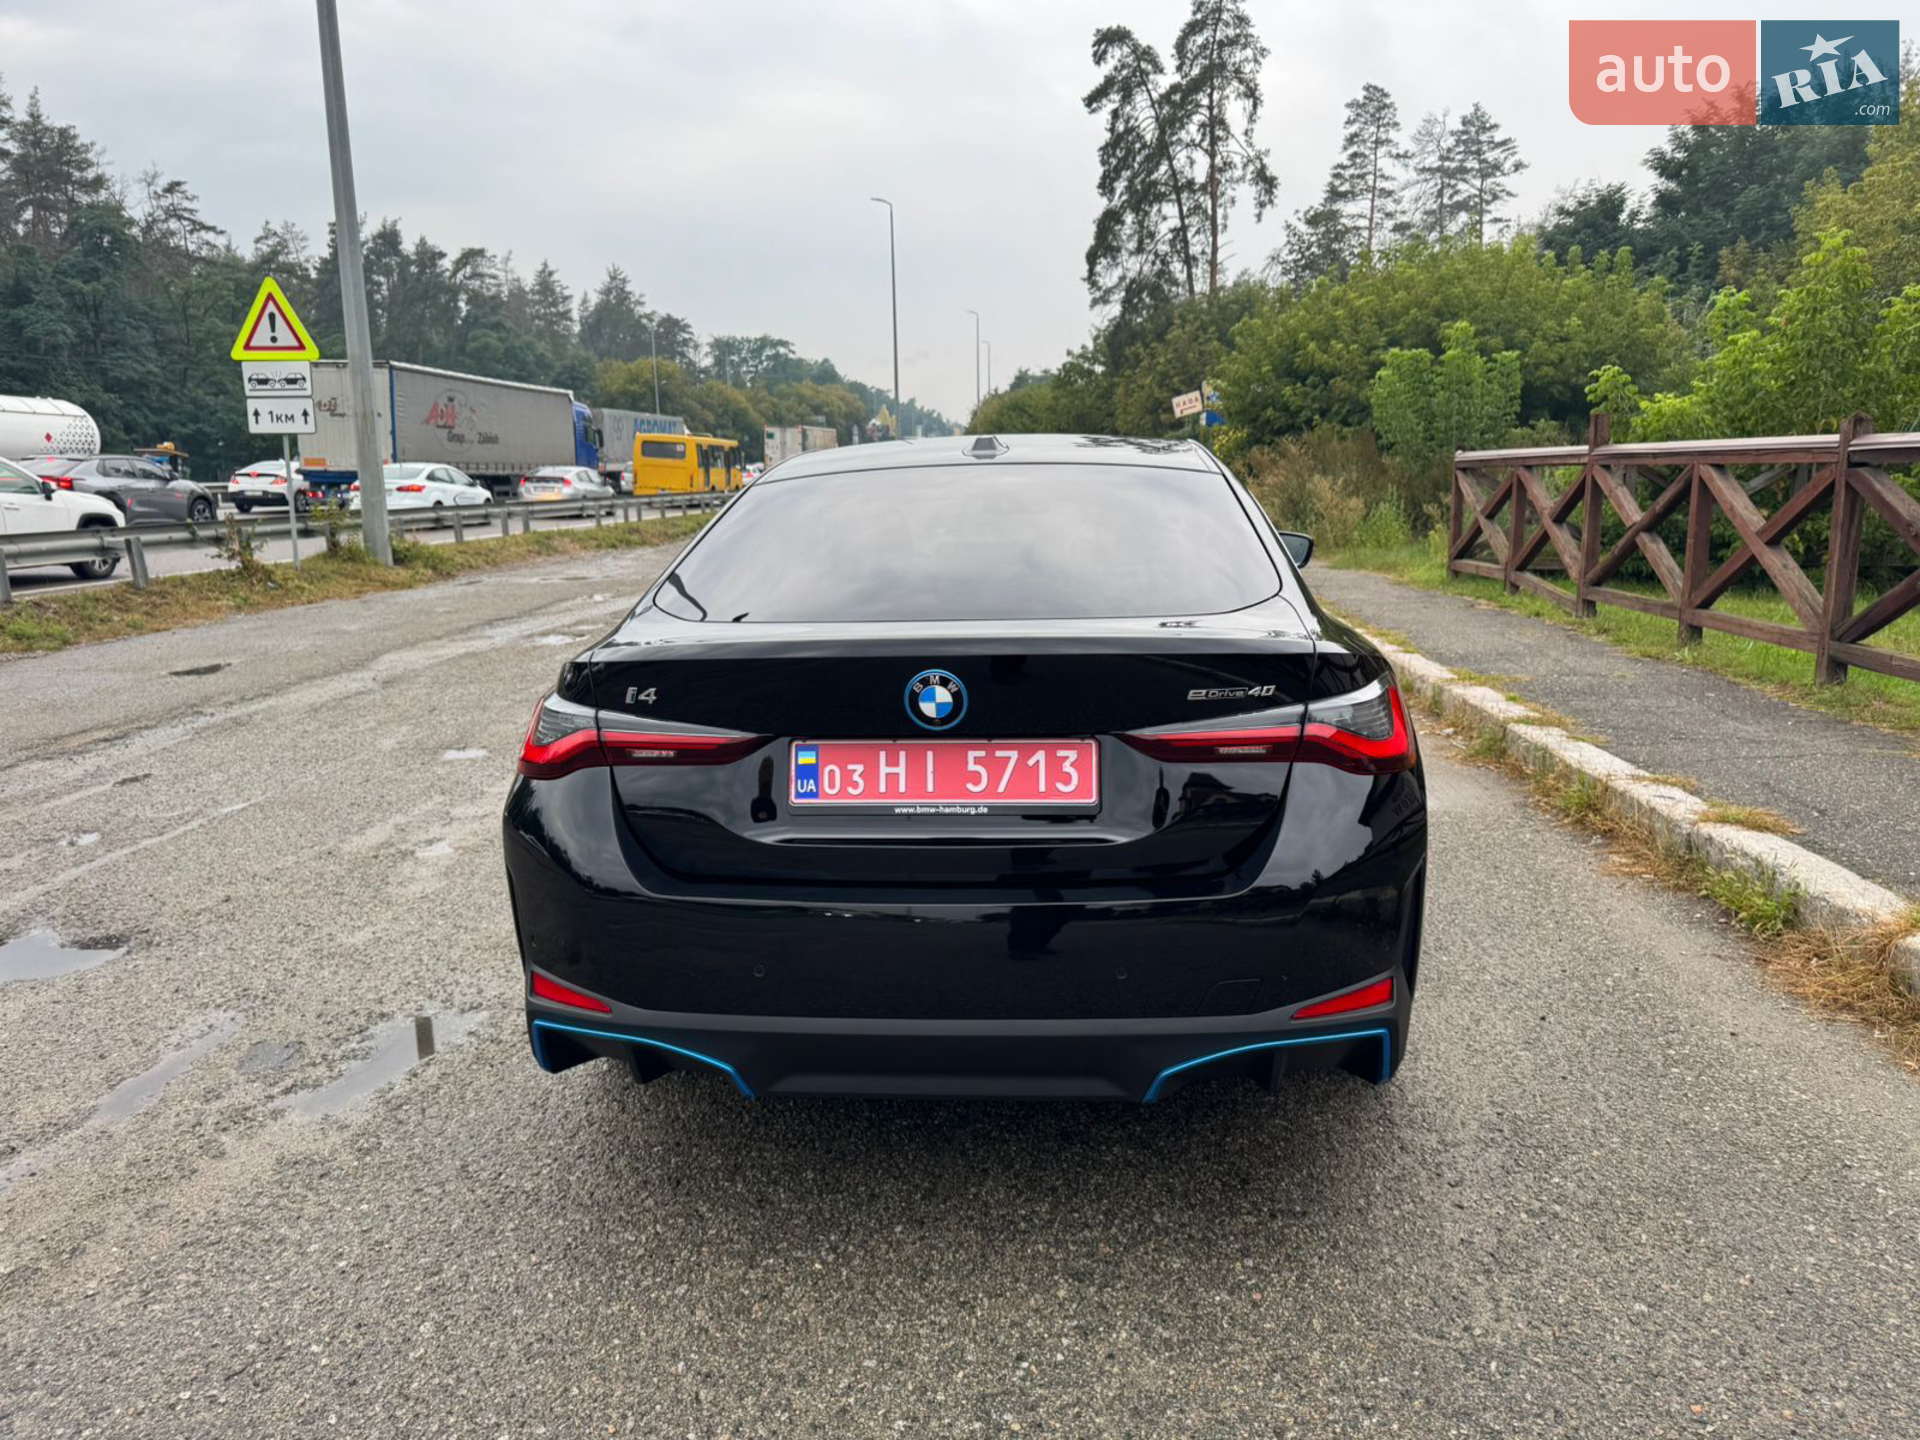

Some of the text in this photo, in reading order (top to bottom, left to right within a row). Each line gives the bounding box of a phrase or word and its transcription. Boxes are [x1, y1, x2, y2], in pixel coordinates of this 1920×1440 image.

[912, 674, 960, 694] BMW
[798, 779, 816, 793] UA
[823, 764, 865, 796] 03
[965, 750, 1080, 794] 5713
[894, 805, 989, 815] www.bmw-hamburg.de
